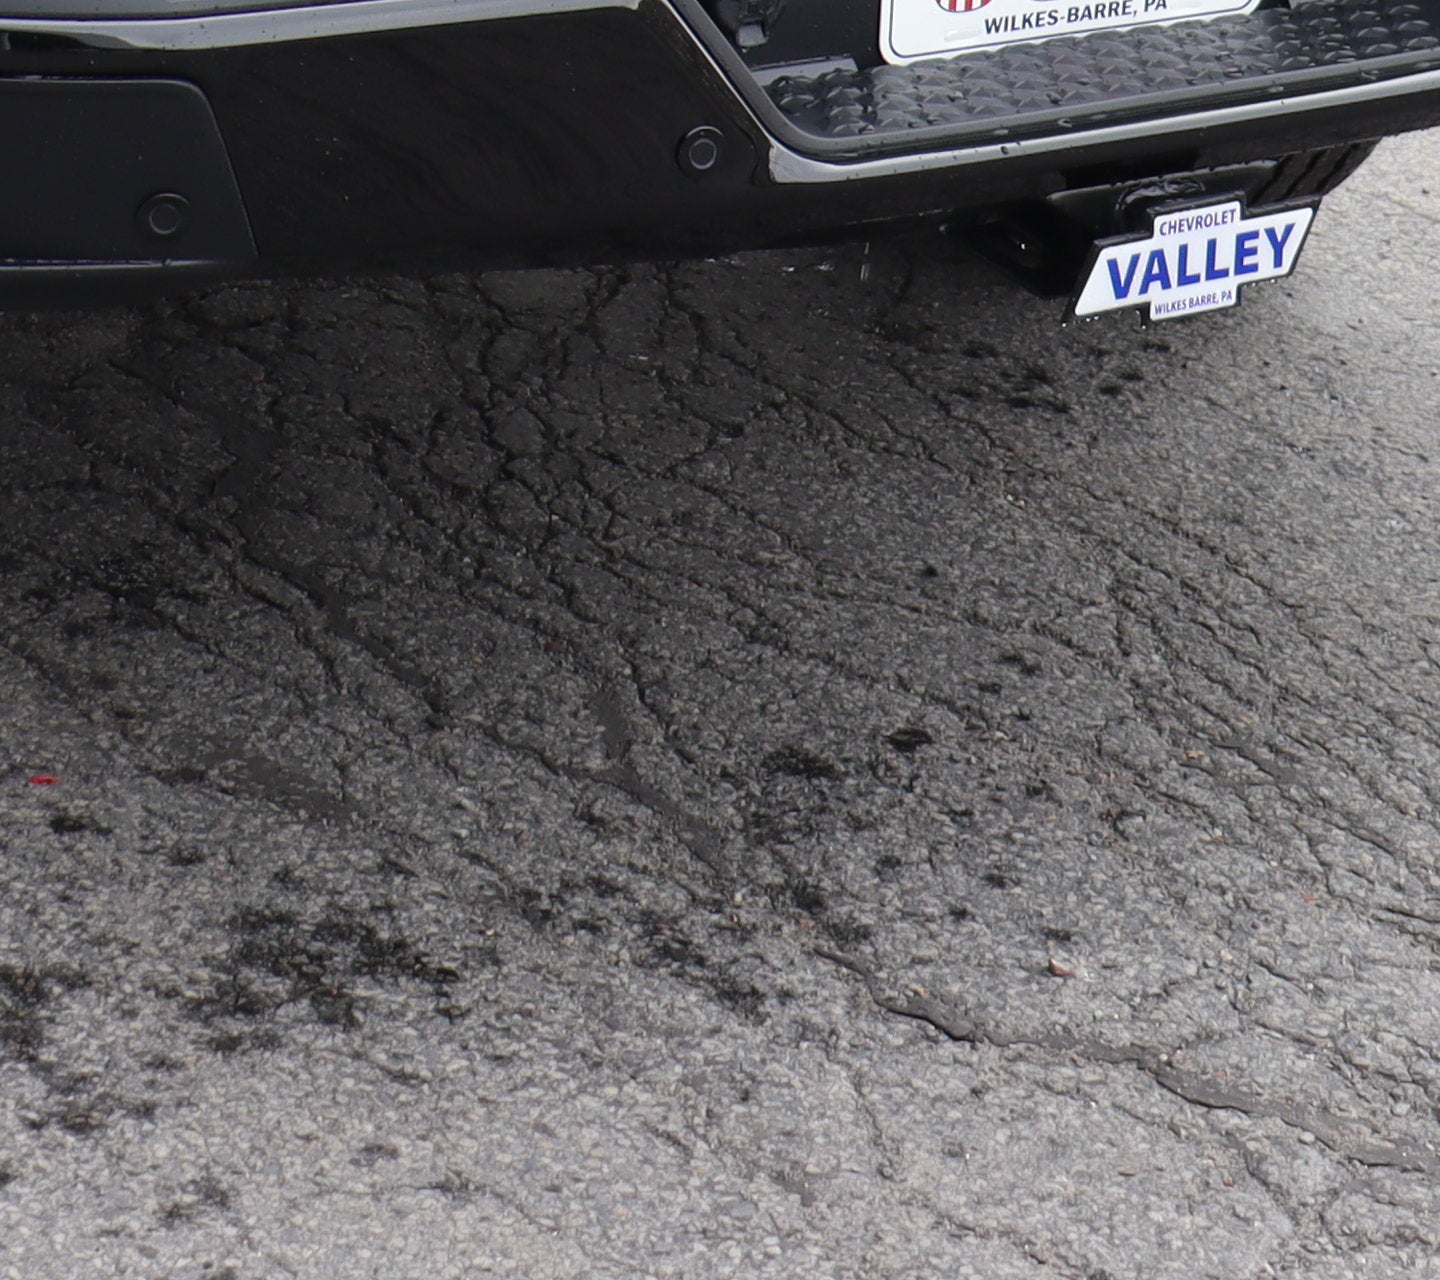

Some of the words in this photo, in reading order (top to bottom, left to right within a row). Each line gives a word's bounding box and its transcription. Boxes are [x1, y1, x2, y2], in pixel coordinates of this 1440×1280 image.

[984, 0, 1139, 36] WILKES-BARRE,
[1159, 208, 1238, 237] CHEVROLET
[1106, 222, 1297, 301] VALLEY
[1154, 298, 1188, 317] WILKES
[1188, 293, 1220, 312] BARRE,
[1221, 290, 1233, 303] PA
